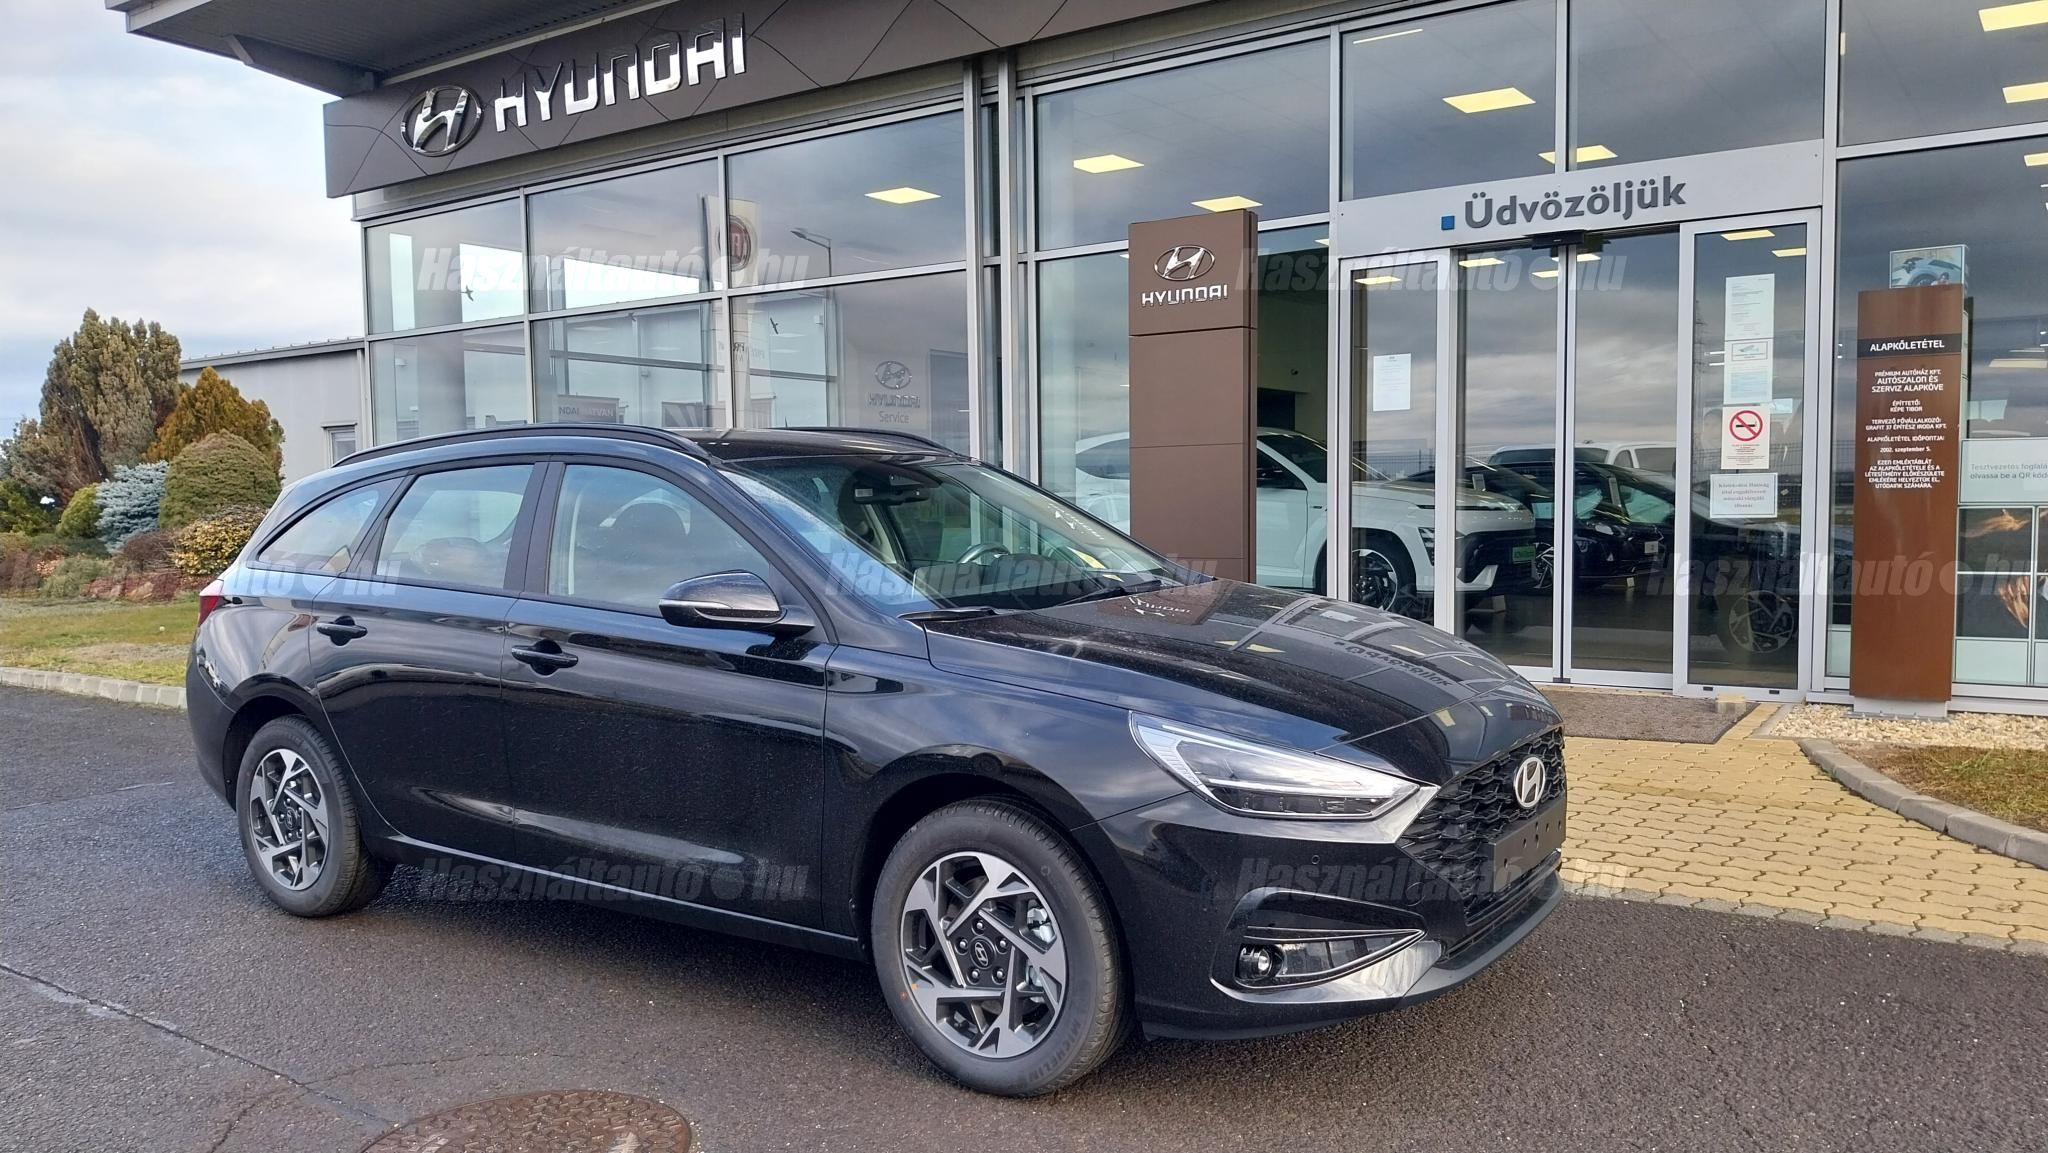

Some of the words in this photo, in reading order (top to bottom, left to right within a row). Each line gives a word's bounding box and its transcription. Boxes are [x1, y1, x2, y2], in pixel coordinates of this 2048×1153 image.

[495, 13, 746, 132] HYUNDAI
[1465, 176, 1686, 228] Üdvözöljük
[1142, 284, 1227, 306] HYUNDAI
[1869, 338, 1945, 352] ALAPKŐLETÉTEL
[1877, 376, 1927, 384] AUTÓSZALON
[1928, 374, 1938, 383] ÉS
[1901, 368, 1928, 376] AUTÓHÁZ
[1871, 385, 1902, 393] SZERVIZ
